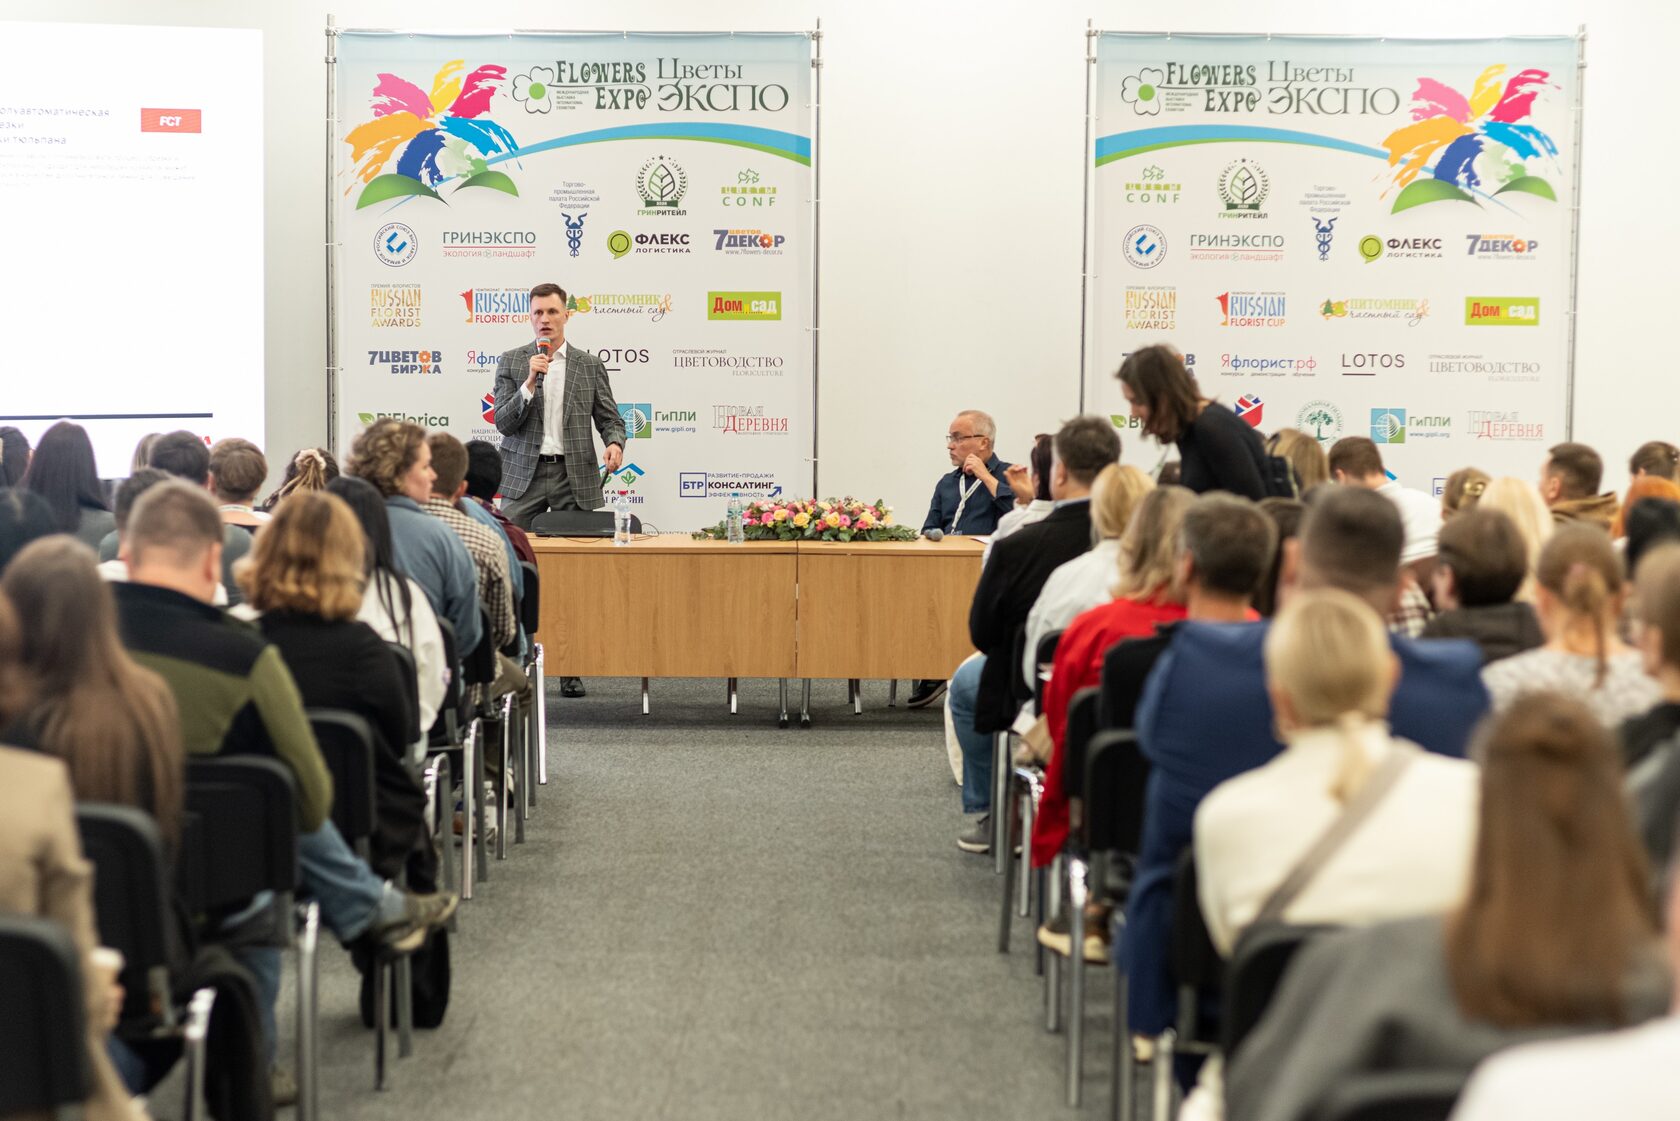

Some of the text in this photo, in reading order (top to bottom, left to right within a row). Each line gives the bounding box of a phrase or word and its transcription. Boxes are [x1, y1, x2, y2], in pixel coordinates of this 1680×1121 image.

[556, 61, 646, 83] FLOWERS
[657, 58, 743, 79] Цветы
[1166, 62, 1256, 86] FLOWERS
[1267, 61, 1354, 83] Цветы
[595, 87, 648, 110] EXPO
[657, 80, 789, 112] ЭКСПО
[1205, 89, 1257, 113] EXPO
[1267, 83, 1400, 115] ЭКСПО
[0, 107, 110, 117] олуавтоматическая
[722, 196, 776, 207] CONF
[1126, 193, 1181, 204] CONF
[637, 208, 687, 216] ГРИНРИТЕЙЛ
[443, 232, 536, 244] ГРИНЭКСПО
[635, 234, 690, 245] ФЛЕКС
[1190, 234, 1285, 247] ГРИНЭКСПО
[1387, 238, 1442, 250] ФЛЕКС
[371, 289, 422, 307] RUSSIAN
[475, 293, 530, 314] RUSSIAN
[594, 294, 661, 305] ПИТОМНИК
[1126, 291, 1177, 310] RUSSIAN
[713, 297, 743, 314] Дом
[752, 300, 777, 314] сад
[1230, 296, 1286, 317] RUSSIAN
[1471, 302, 1536, 320] Дом сад
[371, 308, 421, 318] FLORIST
[1126, 310, 1176, 320] FLORIST
[372, 319, 422, 328] AWARDS
[476, 315, 530, 324] FLORIST CUP
[1126, 321, 1176, 330] AWARDS
[1231, 318, 1286, 327] FLORIST CUP
[368, 351, 442, 365] 7ЦВЕТОВ
[674, 357, 784, 368] ЦВЕТОВОДСТВО
[1221, 354, 1317, 372] Яфлорист.рф
[1342, 353, 1406, 368] LOTOS
[391, 365, 442, 374] БИРЖА
[1430, 362, 1541, 373] ЦВЕТОВОДСТВО
[655, 412, 696, 422] ГиПЛИ
[1409, 417, 1451, 427] ГиПЛИ
[723, 416, 788, 434] ДЕРЕВНЯ
[1478, 421, 1544, 438] ДЕРЕВНЯ
[683, 481, 704, 490] БТР
